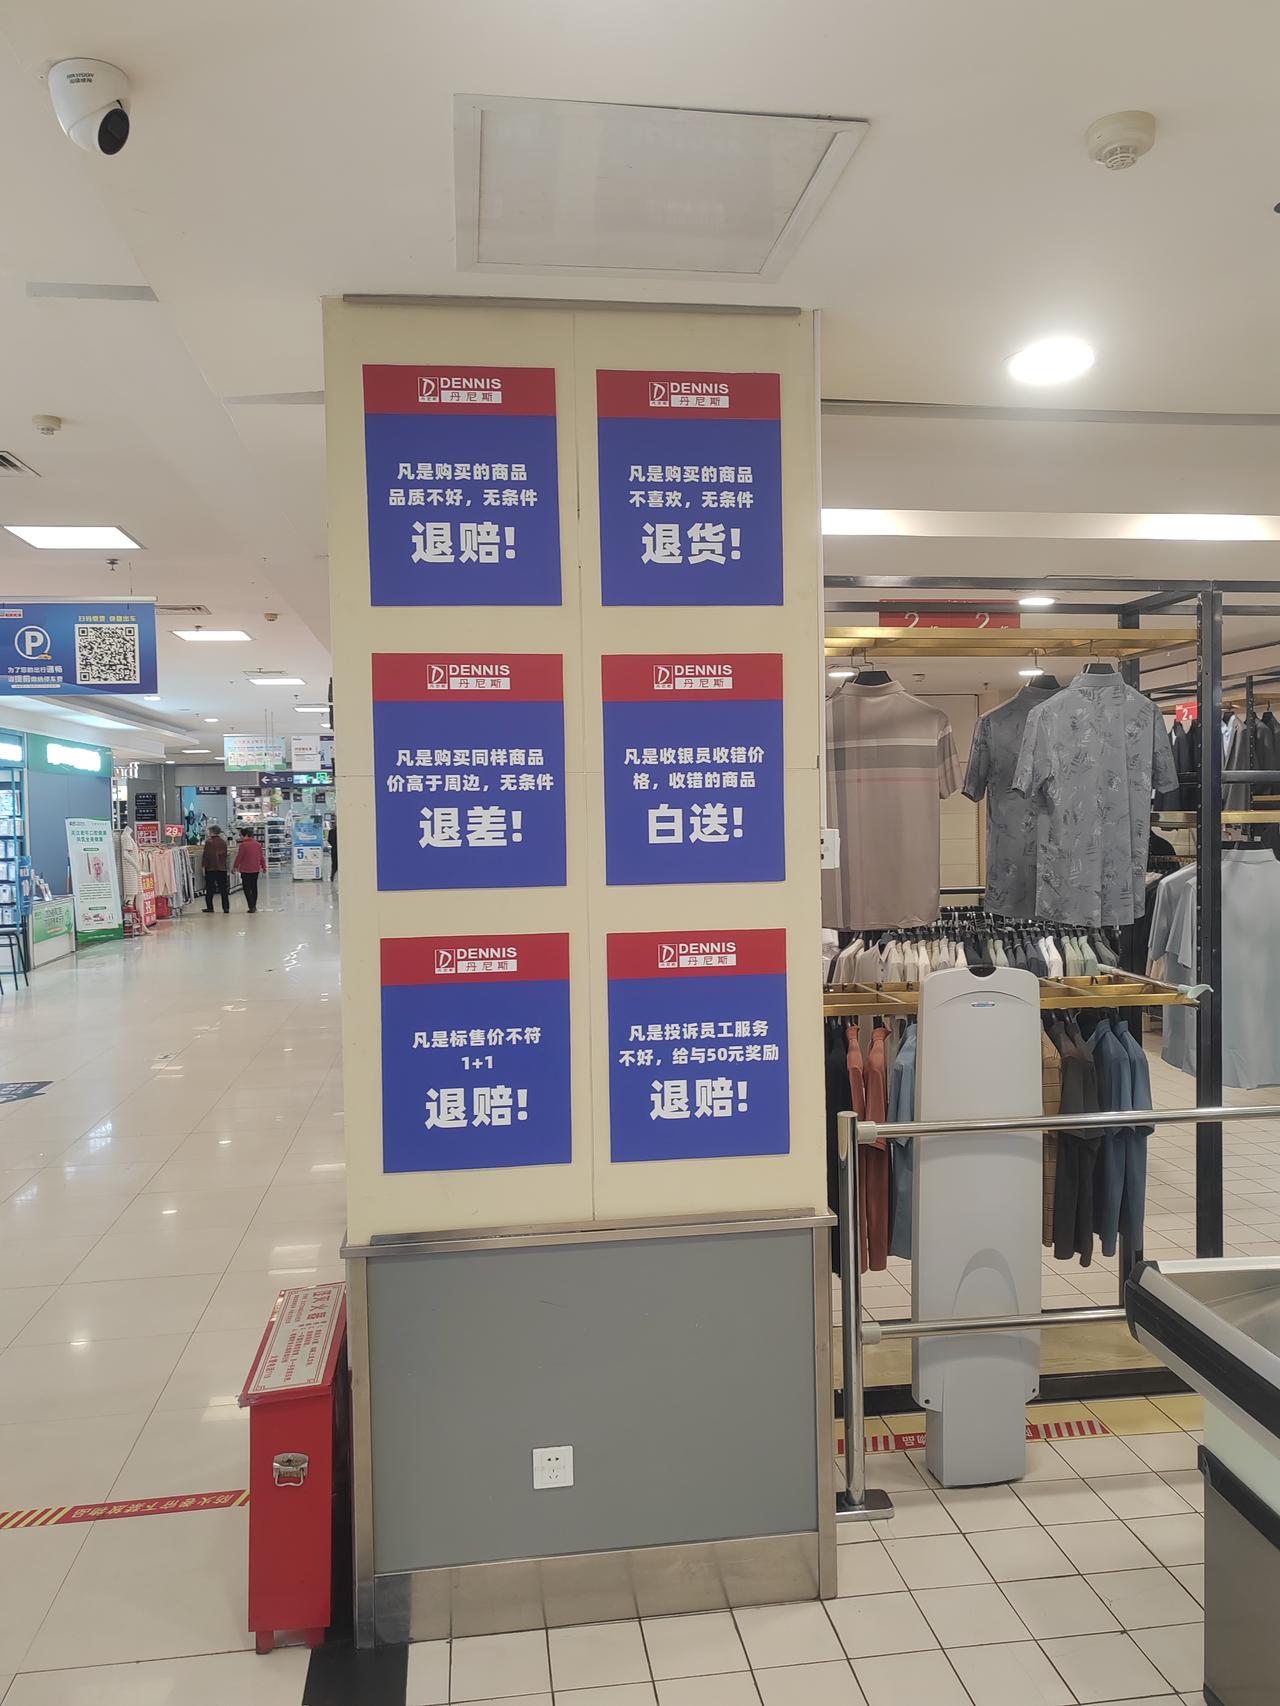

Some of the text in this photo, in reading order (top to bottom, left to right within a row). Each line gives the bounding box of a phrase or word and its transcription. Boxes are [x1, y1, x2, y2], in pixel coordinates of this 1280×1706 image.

[440, 377, 502, 389] DENNIS
[670, 382, 730, 394] DENNIS
[450, 391, 493, 402] 丹尼斯
[679, 396, 721, 406] 丹尼斯
[398, 463, 527, 480] 凡是购买的商品
[629, 466, 752, 483] 凡是购买的商品
[389, 489, 537, 506] 品质不好，无条件
[629, 491, 753, 508] 不喜欢，无条件
[411, 521, 515, 563] 退赔！
[641, 523, 740, 564] 退货！
[25, 631, 44, 656] P
[448, 664, 511, 676] DENNIS
[674, 664, 733, 676] DENNIS
[458, 678, 502, 688] 丹尼斯
[683, 678, 725, 688] 丹尼斯
[396, 749, 543, 766] 凡是购买同样商品
[624, 746, 764, 765] 凡是收银员收错价
[387, 774, 554, 792] 价高于周边，无条件
[633, 771, 755, 789] 格，收错的商品
[419, 806, 522, 848] 退差！
[648, 803, 743, 843] 白送！
[457, 947, 517, 959] DENNIS
[678, 942, 737, 955] DENNIS
[466, 961, 508, 971] 丹尼斯
[687, 955, 728, 966] 丹尼斯
[413, 1027, 541, 1048] 凡是标售价不符
[629, 1020, 768, 1041] 凡是投诉员工服务
[462, 1056, 492, 1069] 1+1
[619, 1044, 778, 1066] 不好，给与50元奖励
[425, 1085, 527, 1129] 退赔！
[650, 1077, 747, 1120] 退赔！
